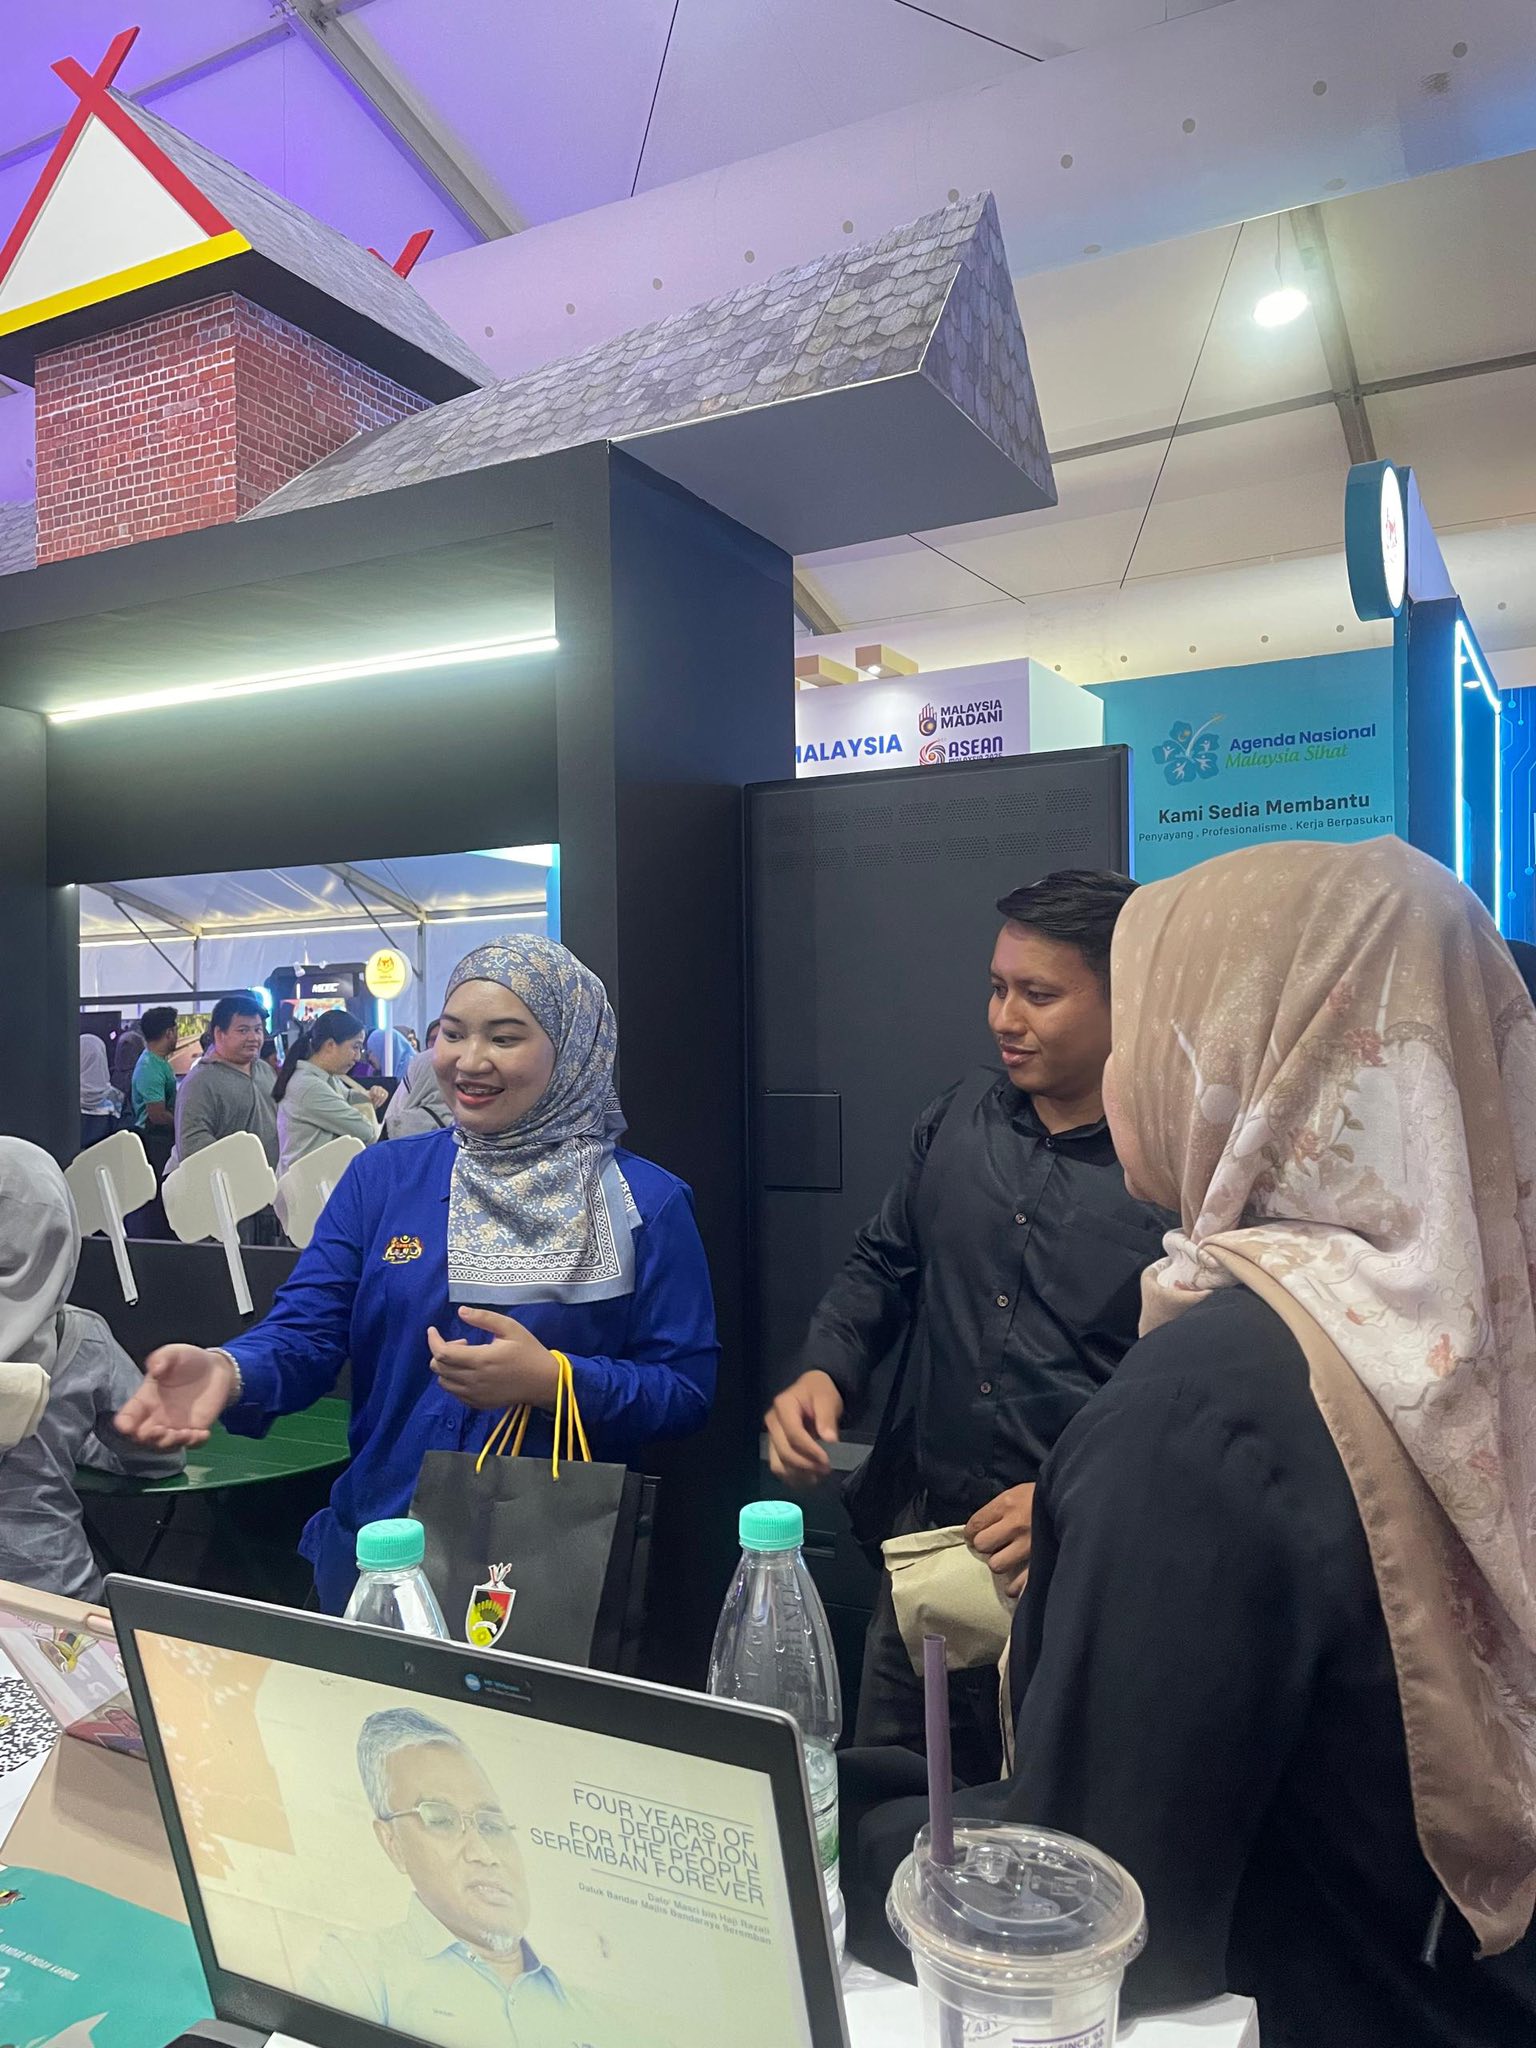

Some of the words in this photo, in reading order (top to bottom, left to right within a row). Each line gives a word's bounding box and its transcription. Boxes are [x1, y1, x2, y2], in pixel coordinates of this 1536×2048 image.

[940, 699, 1002, 717] MALAYSIA
[940, 709, 1003, 729] MADANI
[949, 736, 1003, 757] ASEAN
[1229, 732, 1296, 753] Agenda
[1300, 723, 1376, 744] Nasional
[1225, 750, 1300, 769] Malaysia
[1304, 743, 1348, 761] Sihat
[1158, 805, 1203, 824] Kami
[1208, 801, 1260, 820] Sedia
[1266, 793, 1370, 816] Membantu
[1139, 829, 1194, 842] Penyayang
[1202, 821, 1287, 837] Profesionalisme
[1296, 818, 1324, 830] Kerja
[1327, 813, 1393, 829] Berpasukan
[573, 1788, 634, 1819] FOUR
[638, 1803, 716, 1840] YEARS
[723, 1827, 755, 1849] OF
[569, 1821, 614, 1848] FOR
[618, 1833, 665, 1862] THE
[670, 1848, 762, 1889] PEOPLE
[619, 1817, 759, 1871] DEDICATION
[530, 1827, 648, 1875] SEREMBAN
[654, 1861, 766, 1909] FOREVER
[578, 1881, 605, 1896] Datuk
[606, 1889, 639, 1907] Bandar
[669, 1910, 721, 1931] Bandaraya
[722, 1923, 773, 1945] Seremban
